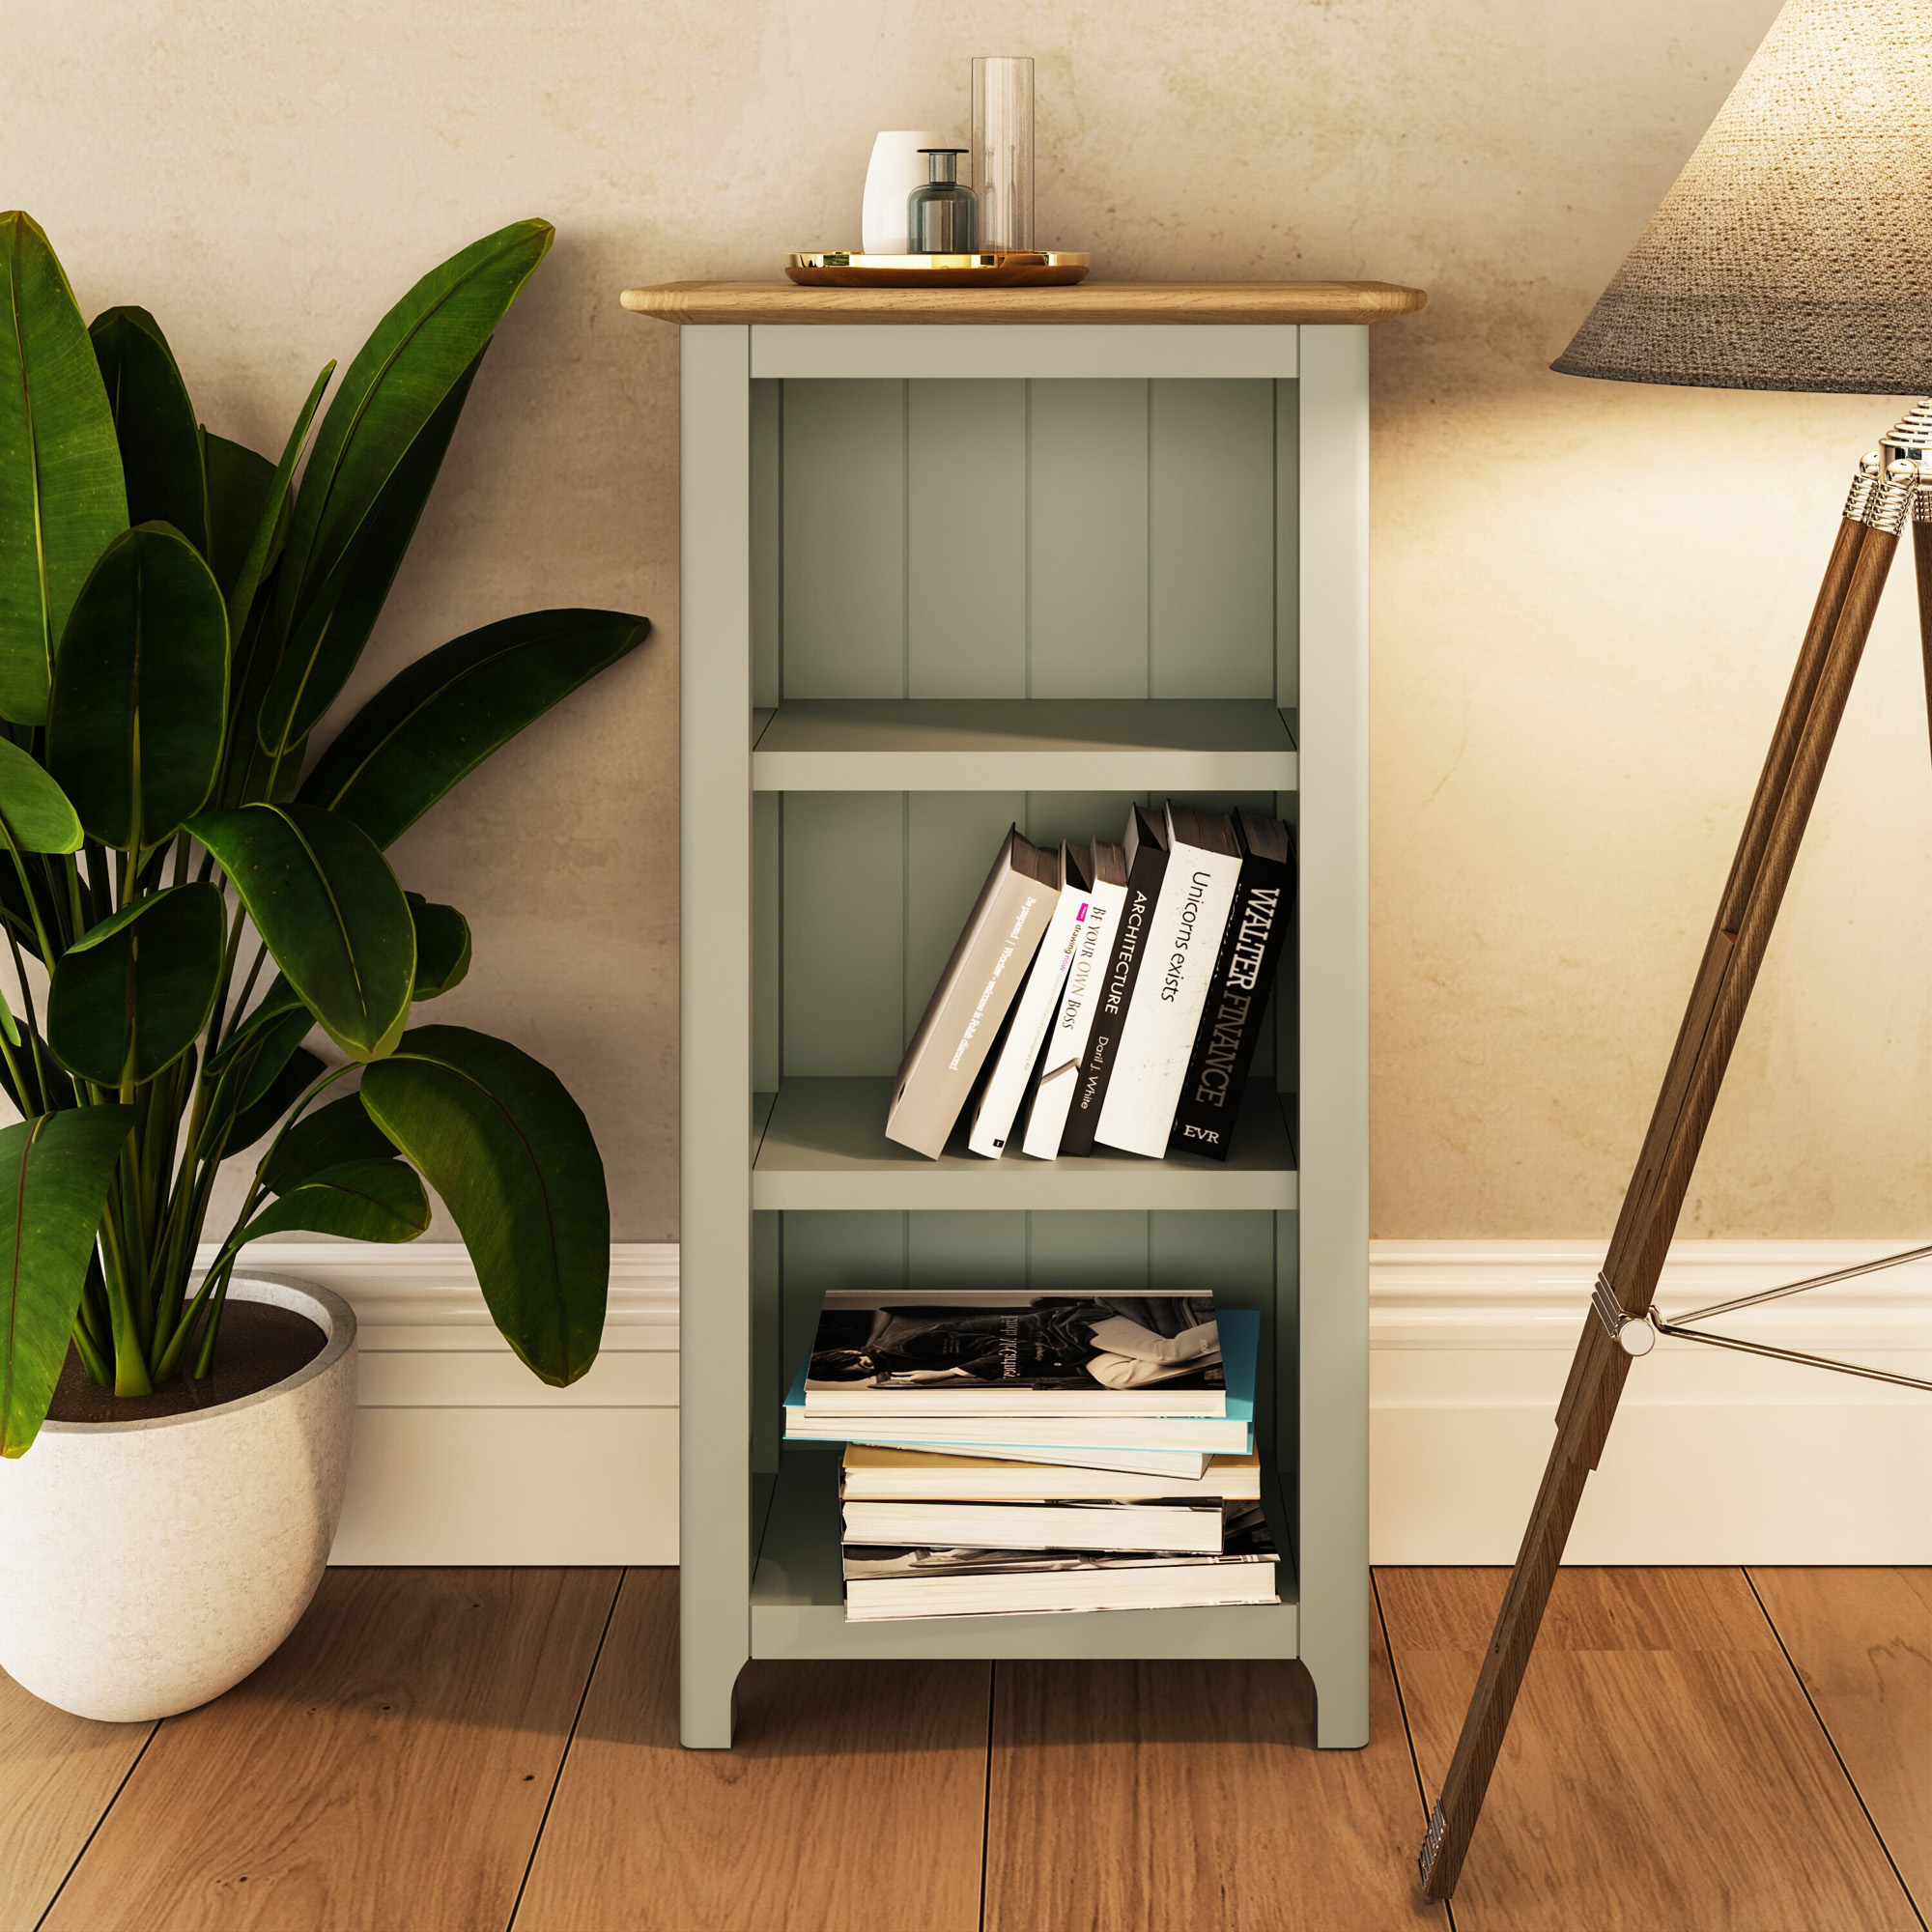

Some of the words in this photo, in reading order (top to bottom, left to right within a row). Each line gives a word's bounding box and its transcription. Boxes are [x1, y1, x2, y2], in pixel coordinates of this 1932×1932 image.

[1025, 896, 1037, 907] Be
[1091, 907, 1106, 922] BE
[1175, 871, 1210, 951] Unicorns
[1009, 905, 1030, 940] prepared
[1064, 924, 1082, 954] drawing
[1226, 888, 1280, 990] WALTER
[1081, 925, 1100, 958] YOUR
[1104, 890, 1148, 1015] ARCHITECTURE
[1060, 954, 1069, 972] now
[1071, 961, 1091, 997] OWN
[1161, 952, 1184, 1003] exists
[963, 1018, 980, 1039] Polish
[973, 1010, 983, 1019] in
[1063, 999, 1081, 1030] BOSS
[949, 1038, 970, 1071] diamond
[1094, 1036, 1109, 1064] Daril
[1195, 990, 1252, 1108] FINANCE
[1080, 1075, 1098, 1110] White
[1182, 1124, 1219, 1144] EVR
